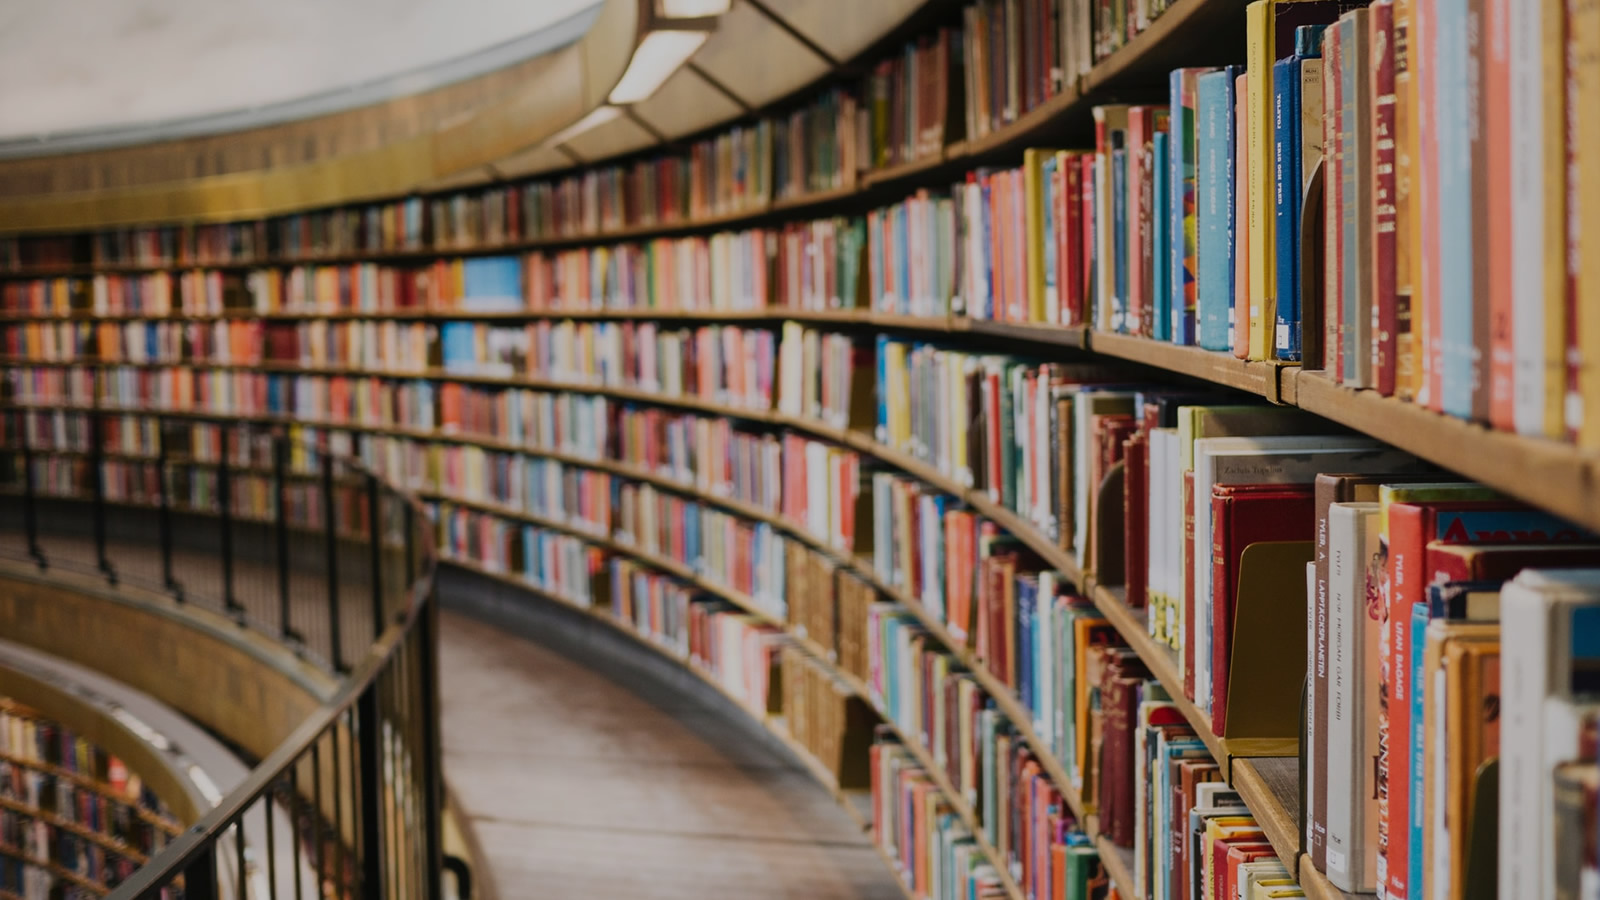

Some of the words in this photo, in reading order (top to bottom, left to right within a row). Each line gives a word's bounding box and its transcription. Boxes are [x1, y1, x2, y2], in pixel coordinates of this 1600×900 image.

[1318, 517, 1326, 547] TYLER,
[1394, 554, 1404, 587] TYLER,
[1395, 621, 1404, 651] UTAN
[1395, 653, 1404, 700] BAGAGE
[1378, 714, 1389, 778] ANNE
[1378, 779, 1389, 847] TYLER
